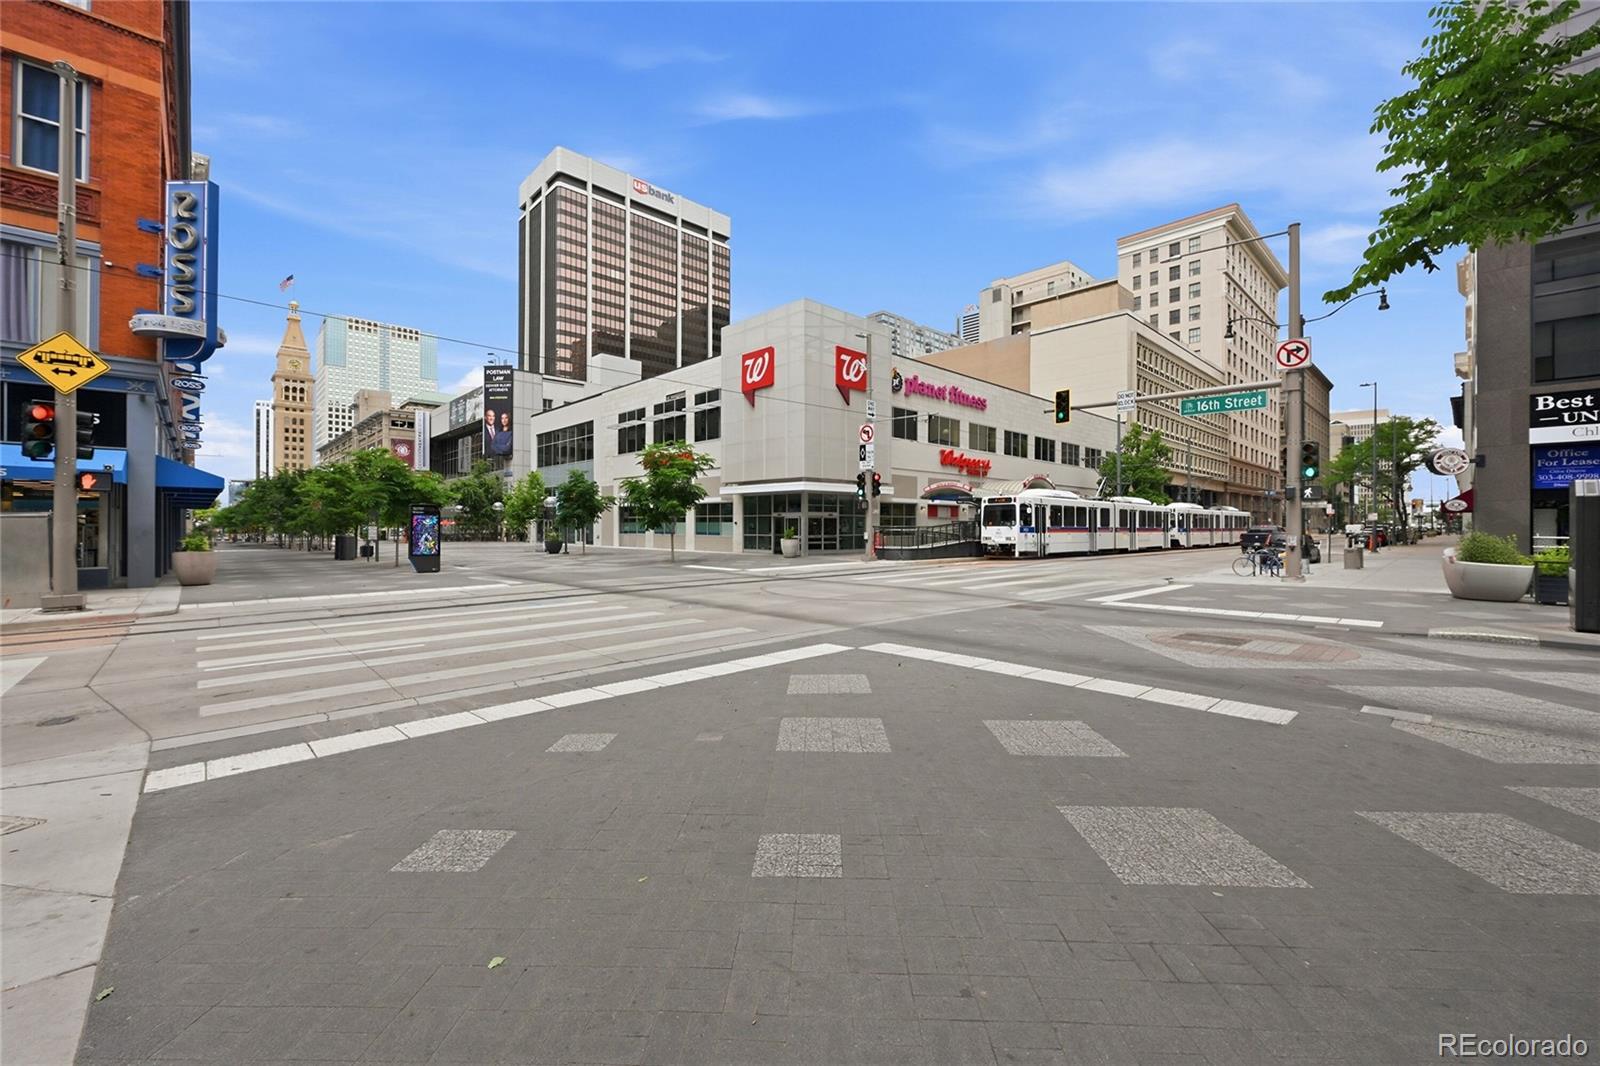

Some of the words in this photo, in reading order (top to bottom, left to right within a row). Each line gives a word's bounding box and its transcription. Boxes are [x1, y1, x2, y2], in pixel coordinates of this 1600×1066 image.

[169, 191, 199, 314] ROSS
[174, 381, 202, 390] ROSS
[904, 375, 948, 400] planet
[948, 385, 987, 410] fitness
[1197, 400, 1220, 412] 16th
[1224, 394, 1262, 408] Street
[1536, 394, 1594, 411] Best
[940, 449, 992, 473] Walgreens
[1548, 449, 1589, 458] Office
[1537, 459, 1558, 467] For
[1562, 458, 1600, 466] Lease
